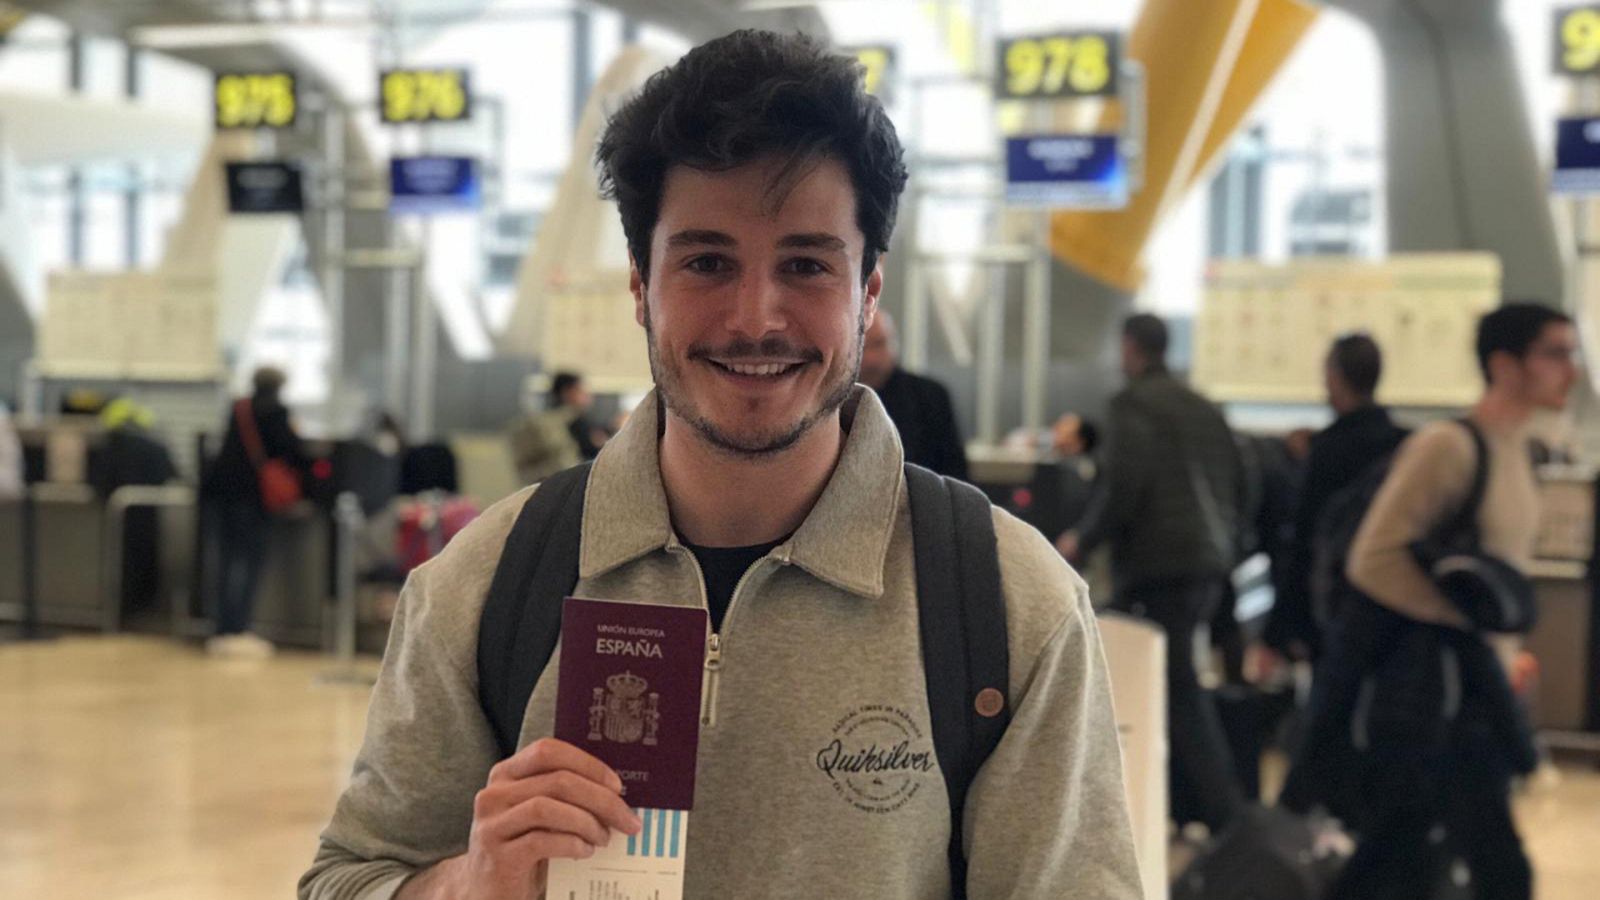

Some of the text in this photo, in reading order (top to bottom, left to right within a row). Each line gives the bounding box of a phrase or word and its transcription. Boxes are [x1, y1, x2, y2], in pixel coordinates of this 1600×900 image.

[1005, 35, 1110, 95] 978
[216, 74, 295, 127] 975
[383, 70, 464, 122] 976
[596, 638, 663, 658] ESPAÑA
[628, 627, 665, 638] EUROPEA
[816, 738, 935, 780] Quiksilver
